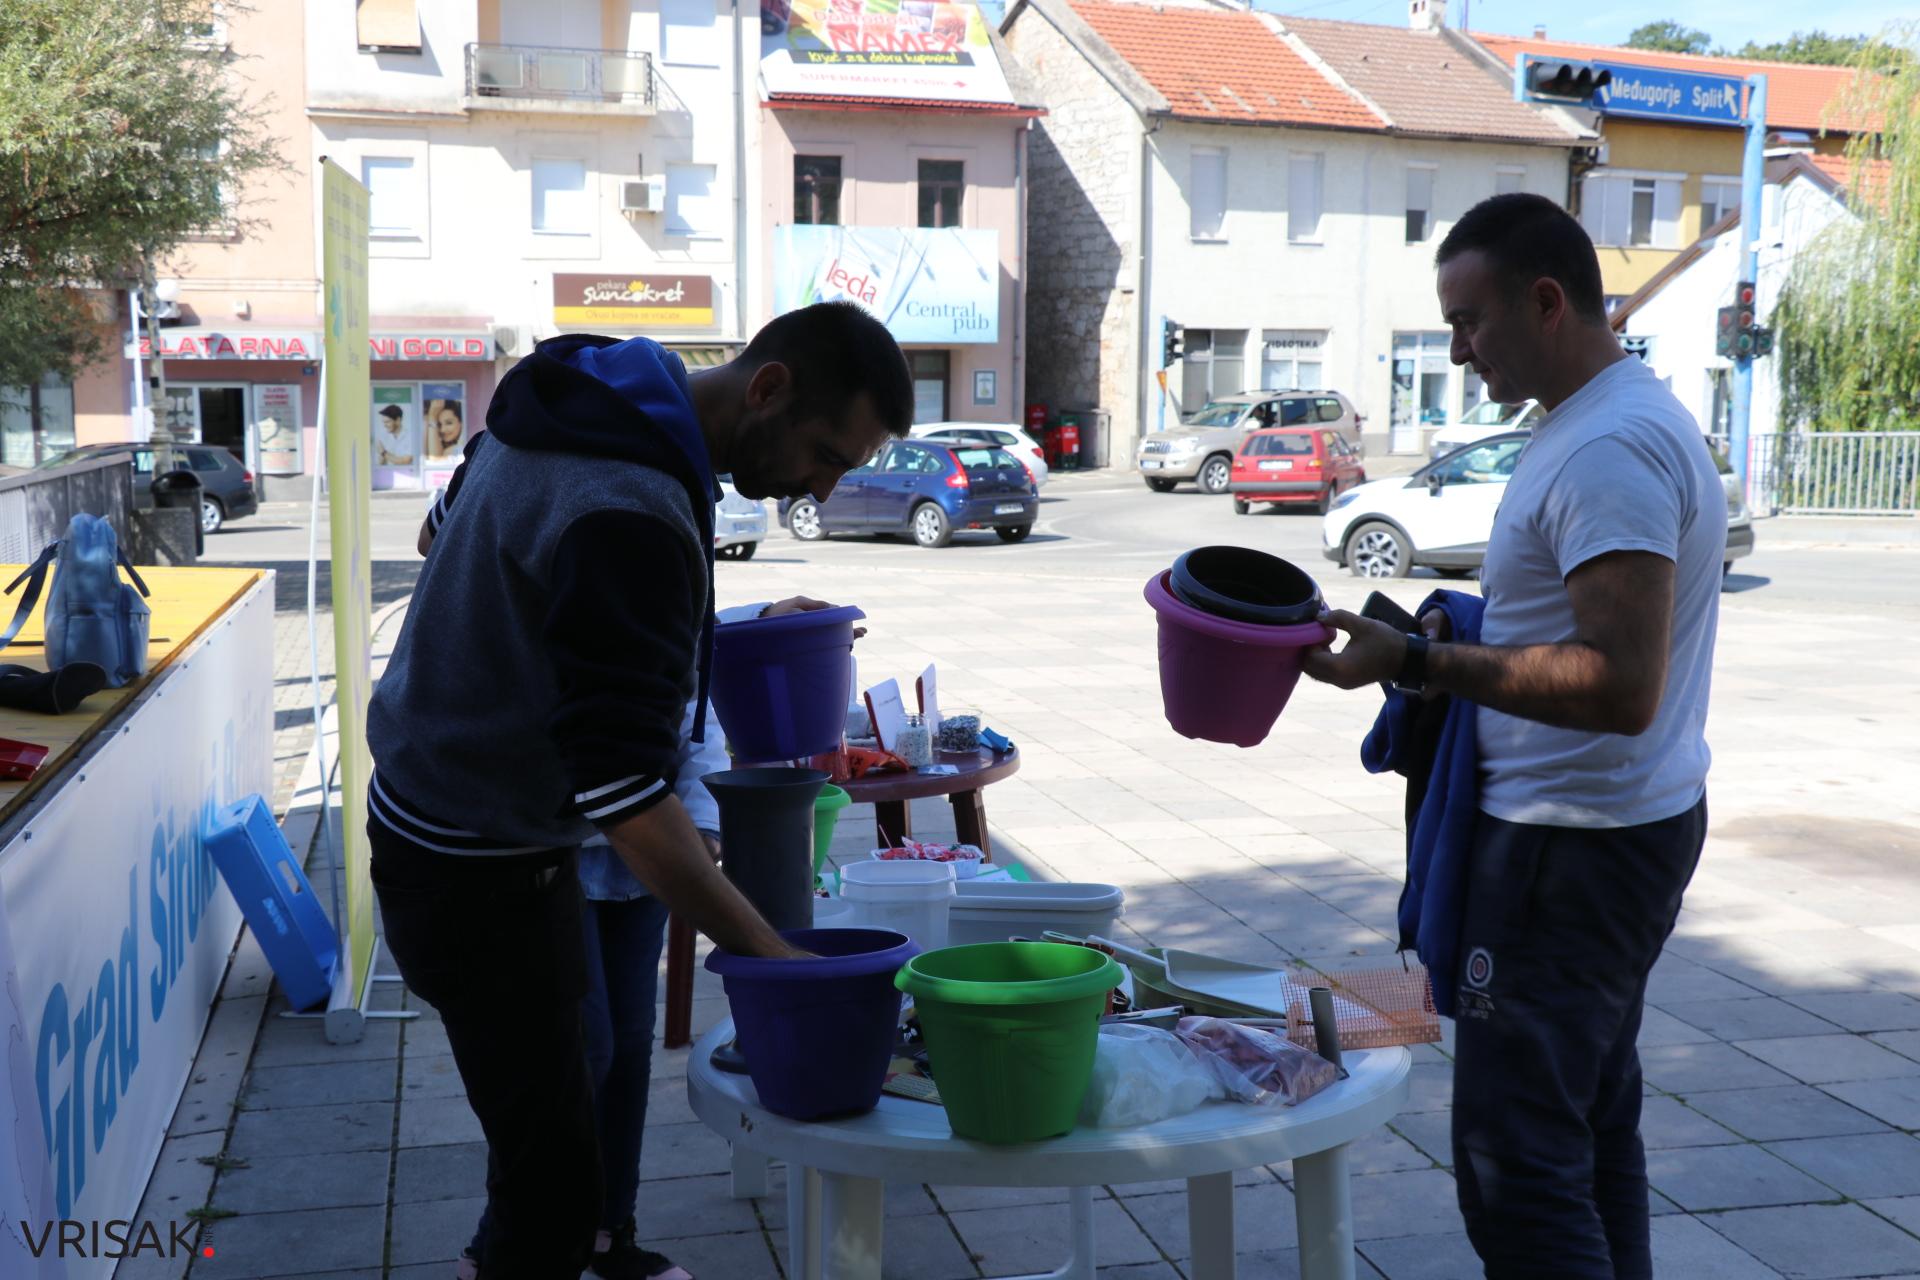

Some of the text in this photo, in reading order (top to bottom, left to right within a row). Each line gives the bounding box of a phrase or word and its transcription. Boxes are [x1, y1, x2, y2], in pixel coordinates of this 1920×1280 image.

[828, 31, 965, 52] NAMEX
[1692, 85, 1724, 112] Split
[825, 258, 878, 305] leda
[906, 300, 976, 318] Central
[953, 313, 990, 334] pub
[139, 336, 307, 355] ZLATARNA
[402, 337, 484, 357] GOLD
[35, 863, 139, 1222] Grad
